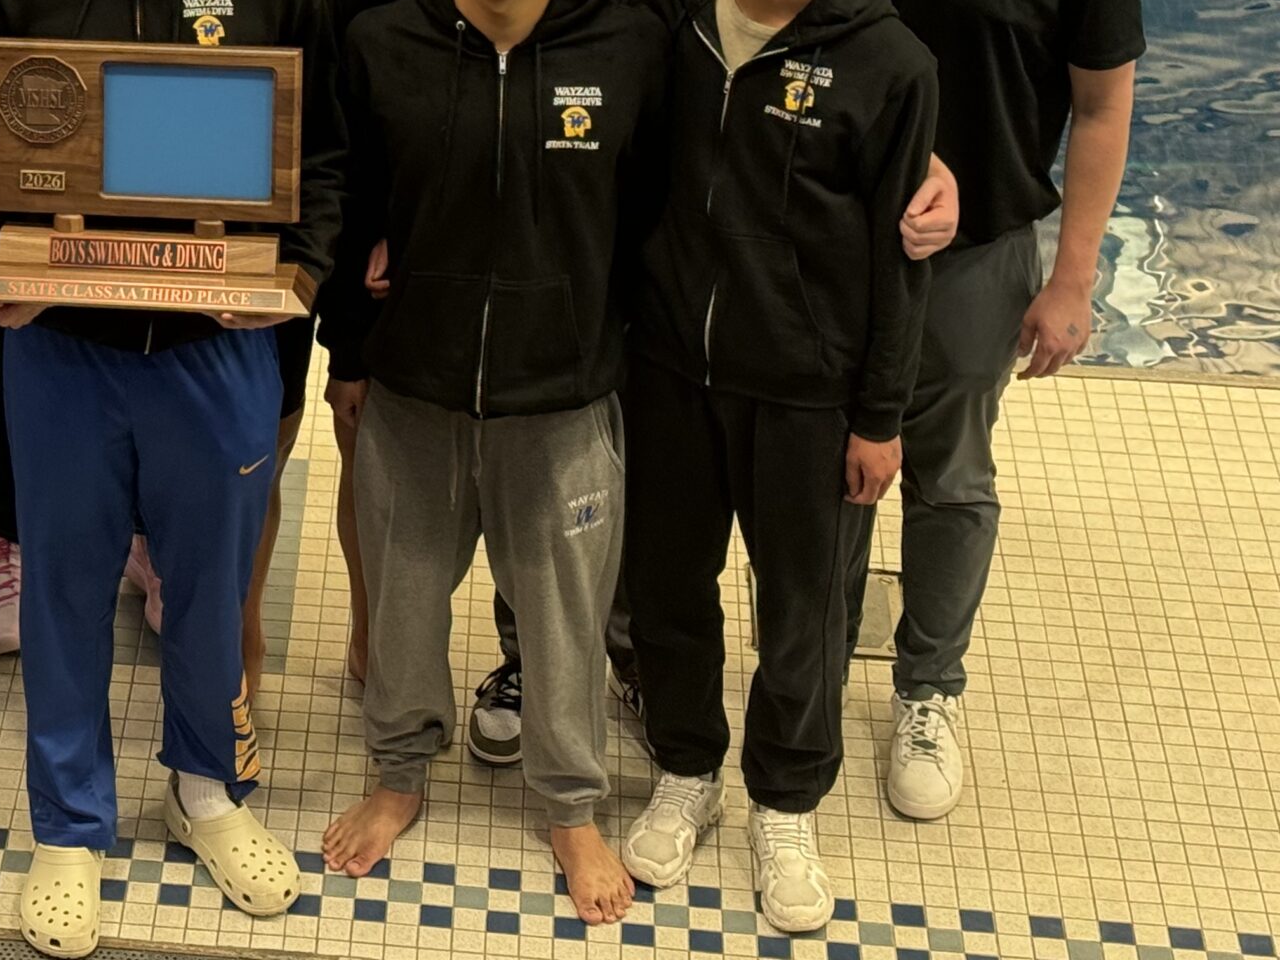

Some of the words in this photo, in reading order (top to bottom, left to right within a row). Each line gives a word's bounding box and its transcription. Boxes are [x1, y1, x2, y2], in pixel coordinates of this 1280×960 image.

[554, 86, 603, 96] WAYZATA
[25, 173, 61, 188] 2026
[51, 239, 85, 264] BOYS
[87, 240, 160, 267] SWIMMING
[162, 244, 173, 267] &
[175, 244, 223, 270] DIVING
[7, 281, 58, 296] STATE
[61, 283, 113, 299] CLASS
[114, 286, 138, 300] AA
[140, 287, 193, 303] THIRD
[196, 289, 251, 305] PLACE
